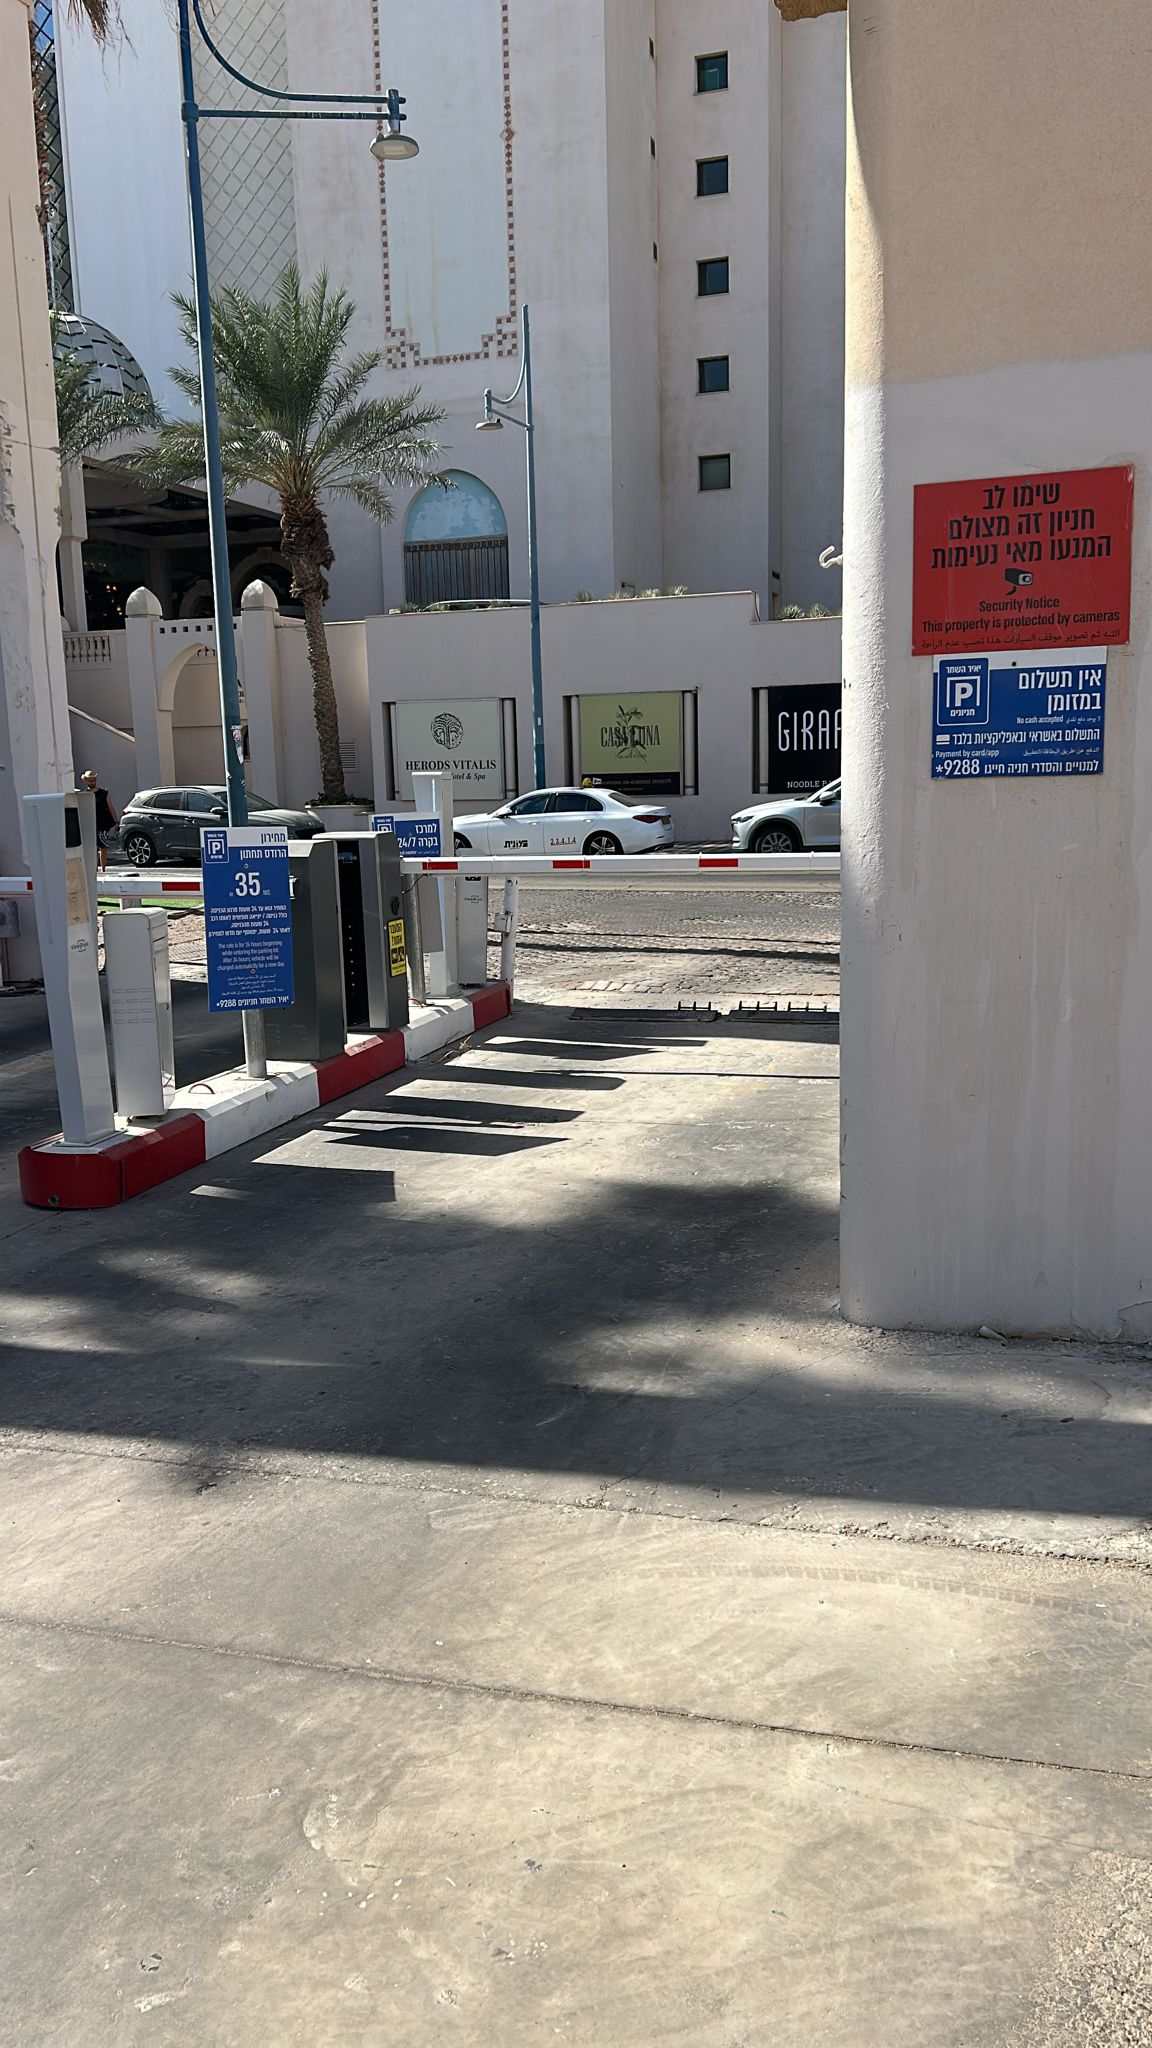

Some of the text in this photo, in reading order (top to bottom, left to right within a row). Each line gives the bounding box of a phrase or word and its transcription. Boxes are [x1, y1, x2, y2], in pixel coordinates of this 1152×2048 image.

[982, 483, 1060, 510] שימו לב
[950, 508, 1094, 540] חניון זה מצולם
[932, 536, 1111, 568] המנעו מאי נעימות
[979, 596, 1060, 614] Security Notice
[922, 610, 1120, 634] This property is protected by cameras
[968, 664, 982, 672] יאיר
[1018, 670, 1102, 690] אין תשלום
[1048, 693, 1101, 714] במזומן
[950, 708, 975, 716] חניונים
[1038, 715, 1064, 724] accepted
[601, 726, 628, 747] CASA
[952, 728, 1100, 746] התשלום באשראי ובאפליקציות בלבד
[936, 749, 1000, 759] Payment by card/app
[406, 760, 496, 770] HERODS VITALIS
[984, 764, 1004, 774] חייגו
[1008, 763, 1028, 774] חניה
[1032, 762, 1062, 773] והסדרי
[1066, 760, 1098, 772] למנויים
[474, 773, 486, 781] Spa
[415, 823, 437, 834] למרכז
[261, 833, 285, 844] מחירון
[397, 837, 438, 848] בקרה 24/7
[240, 849, 286, 860] הרודס תחתון
[235, 872, 260, 896] 35
[238, 997, 258, 1006] חניונים
[259, 996, 276, 1004] השחר
